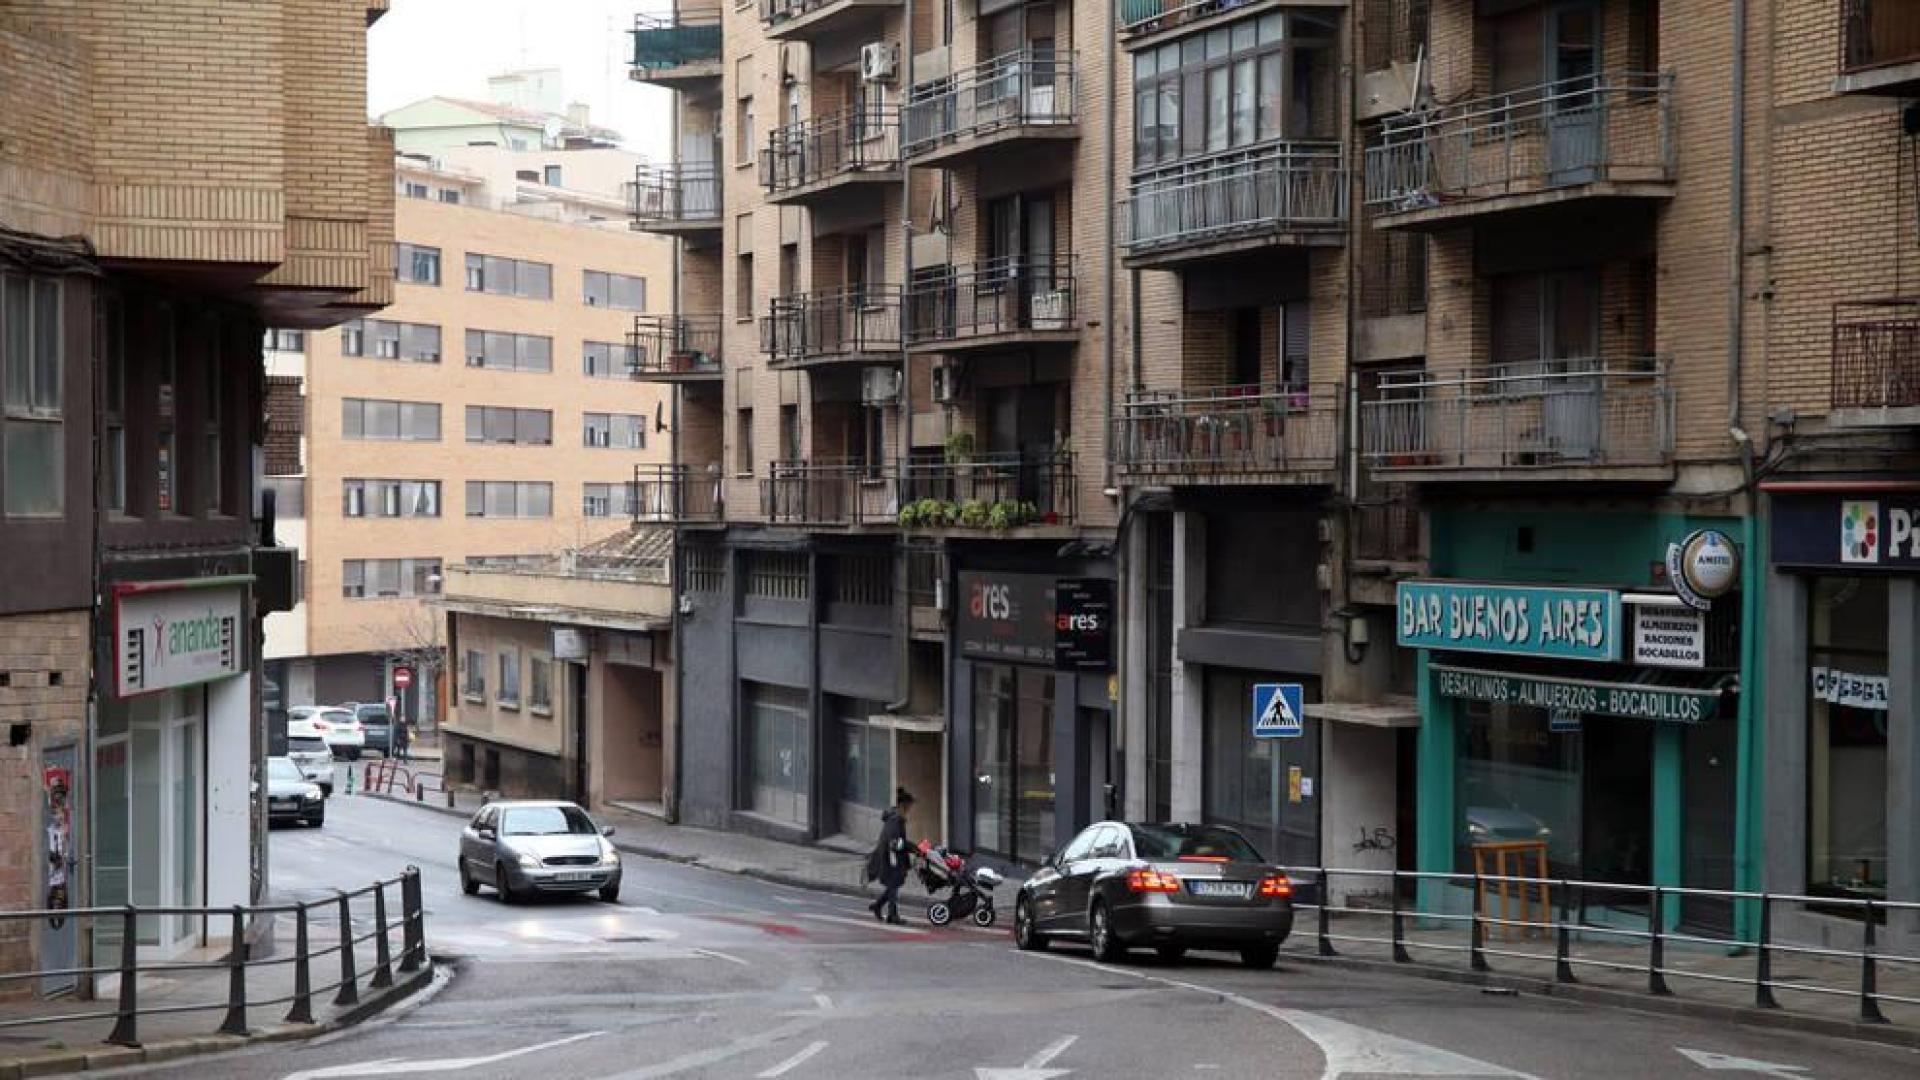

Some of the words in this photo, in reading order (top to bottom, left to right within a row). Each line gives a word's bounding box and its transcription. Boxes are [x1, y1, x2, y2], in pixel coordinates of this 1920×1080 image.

[969, 582, 1009, 619] ares
[168, 608, 219, 655] ananda
[1057, 613, 1098, 631] ares
[1402, 592, 1442, 637] BAR
[1449, 594, 1529, 644] BUENOS
[1539, 600, 1604, 648] AIRES
[1640, 620, 1698, 632] ALMUERZOS
[1638, 647, 1700, 660] BOCADILLOS
[1644, 634, 1693, 646] RACIONES
[1440, 672, 1508, 702] DESAYUNOS
[1520, 682, 1597, 712] ALMUERZOS
[1609, 692, 1700, 721] BOCADILLOS
